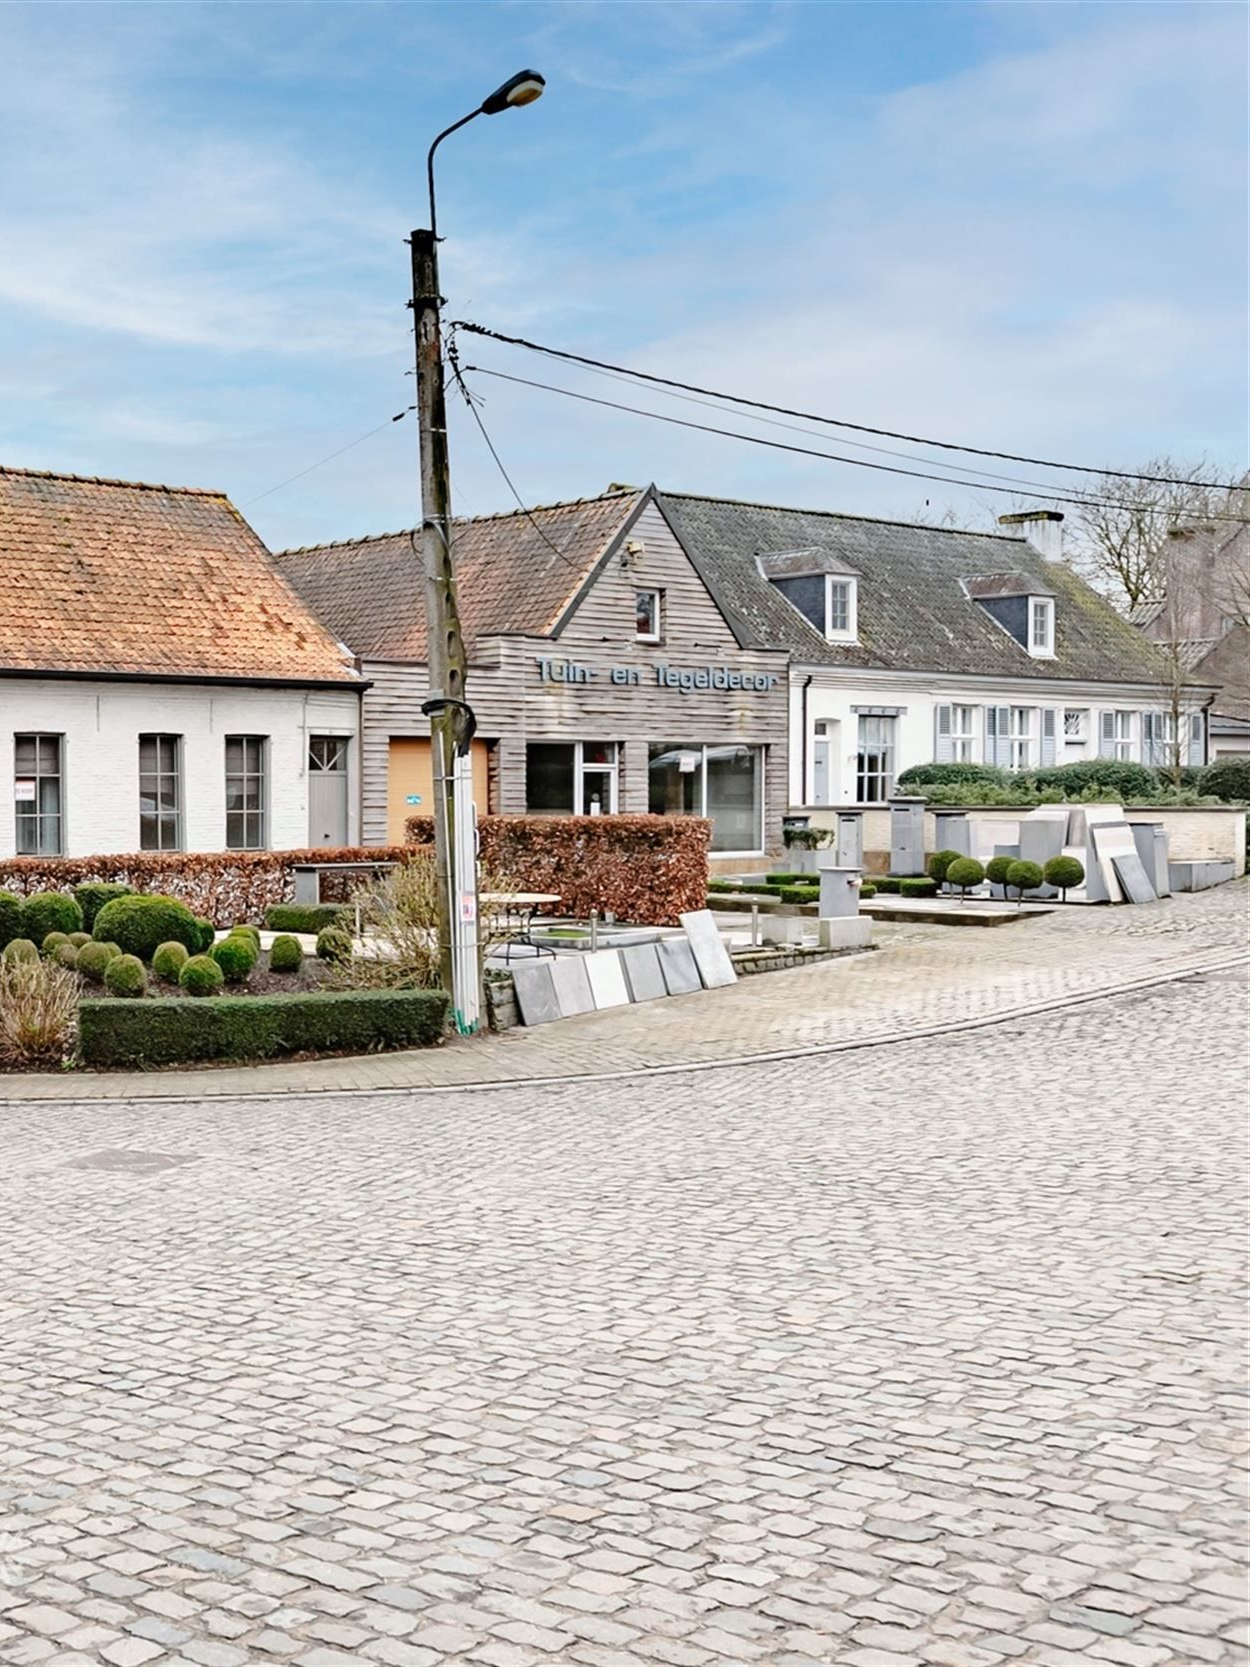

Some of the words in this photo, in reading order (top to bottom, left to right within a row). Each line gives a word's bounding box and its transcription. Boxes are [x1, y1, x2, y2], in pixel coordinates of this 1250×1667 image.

[536, 656, 597, 684] Tuin-
[611, 667, 641, 685] en
[652, 662, 779, 694] Tegeldecor
